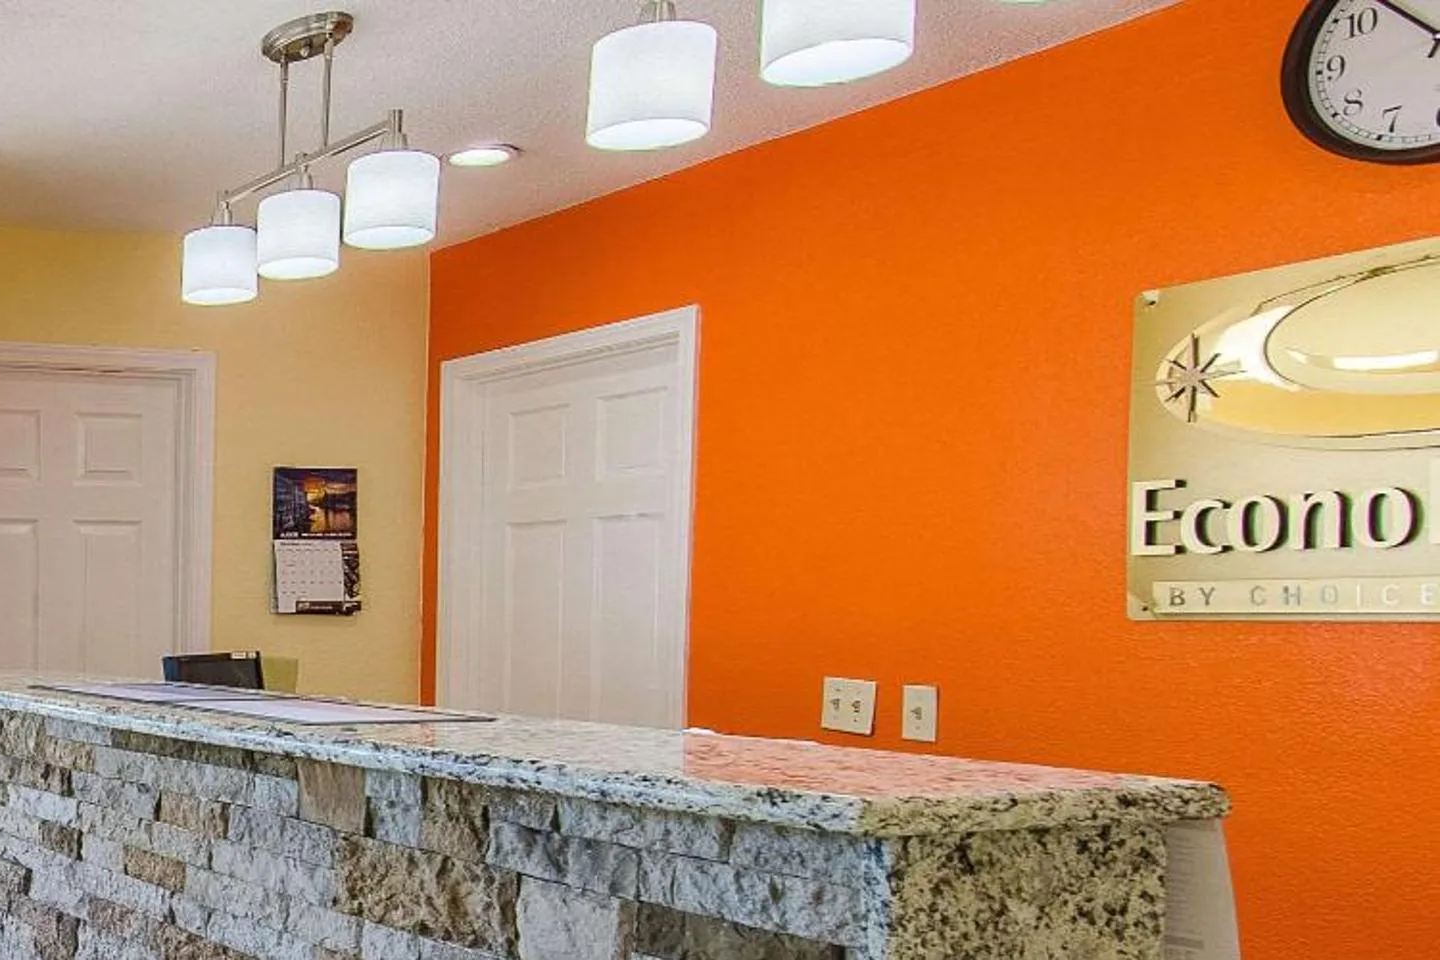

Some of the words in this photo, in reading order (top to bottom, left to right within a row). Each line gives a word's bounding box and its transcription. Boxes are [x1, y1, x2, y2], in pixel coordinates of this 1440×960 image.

[1343, 7, 1378, 40] 10
[1326, 55, 1346, 81] 9
[1343, 89, 1364, 116] 8
[1381, 105, 1402, 133] 7
[1169, 585, 1216, 607] BY
[1249, 583, 1438, 607] CHOICE
